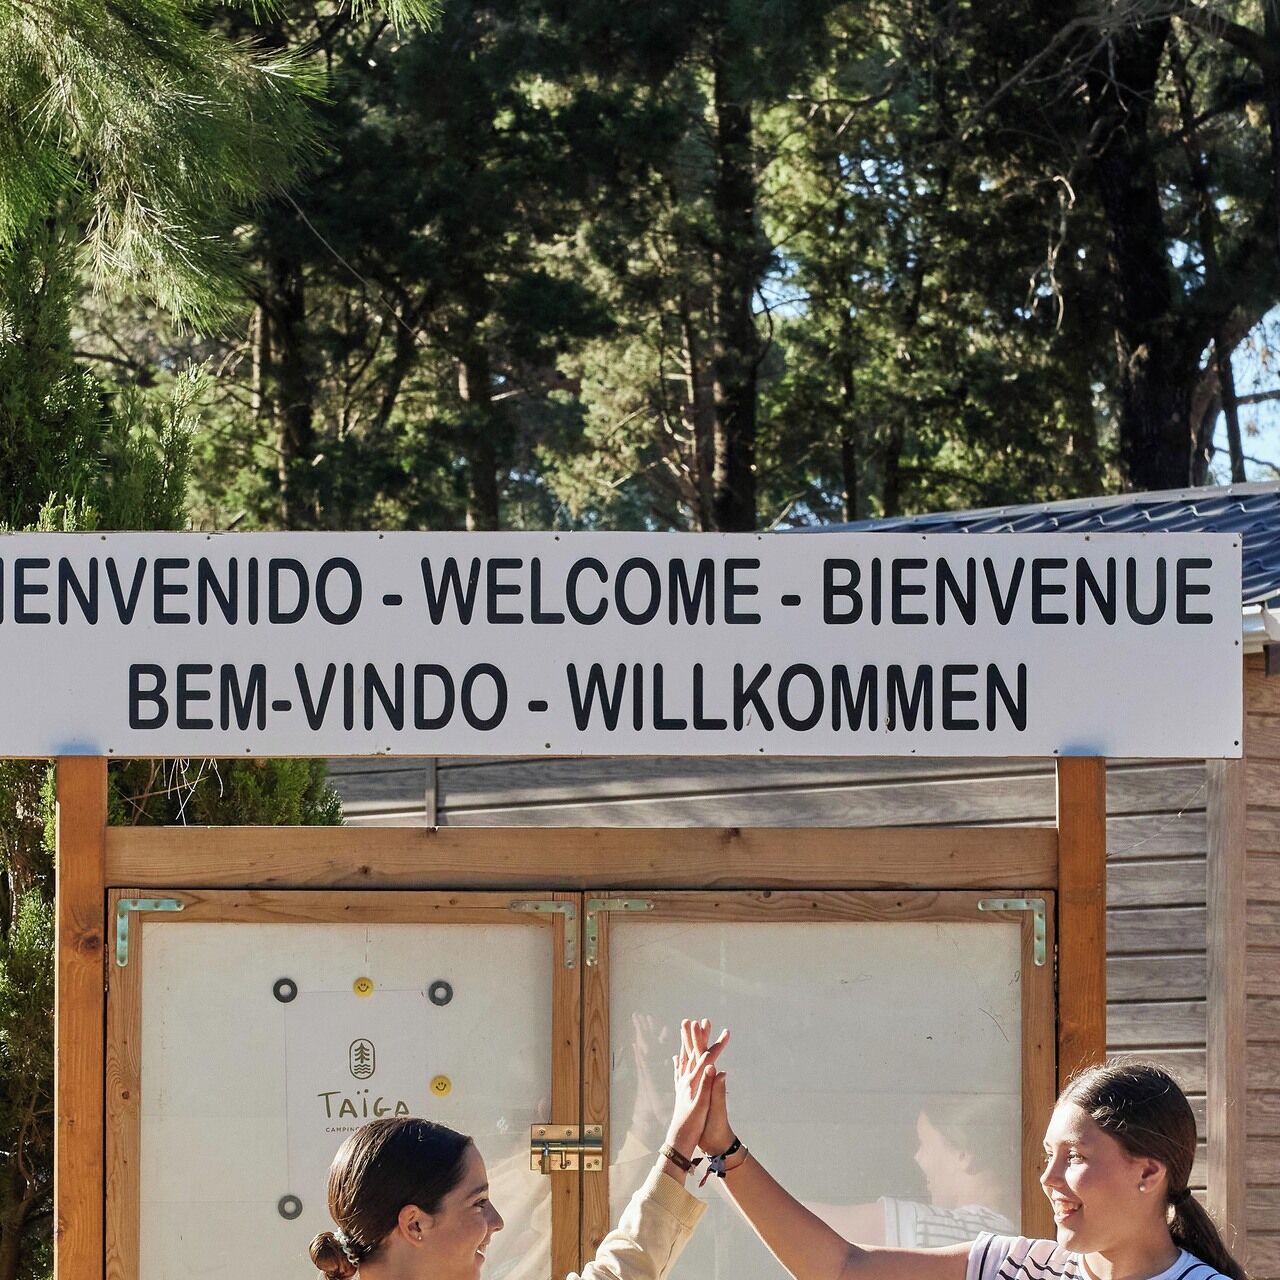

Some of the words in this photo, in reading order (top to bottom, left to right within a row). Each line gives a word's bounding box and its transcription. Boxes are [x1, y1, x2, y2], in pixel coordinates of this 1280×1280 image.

[420, 556, 761, 625] WELCOME
[823, 556, 1213, 625] BIENVENUE
[128, 662, 507, 731] BEM-VINDO
[566, 662, 1026, 731] WILLKOMMEN
